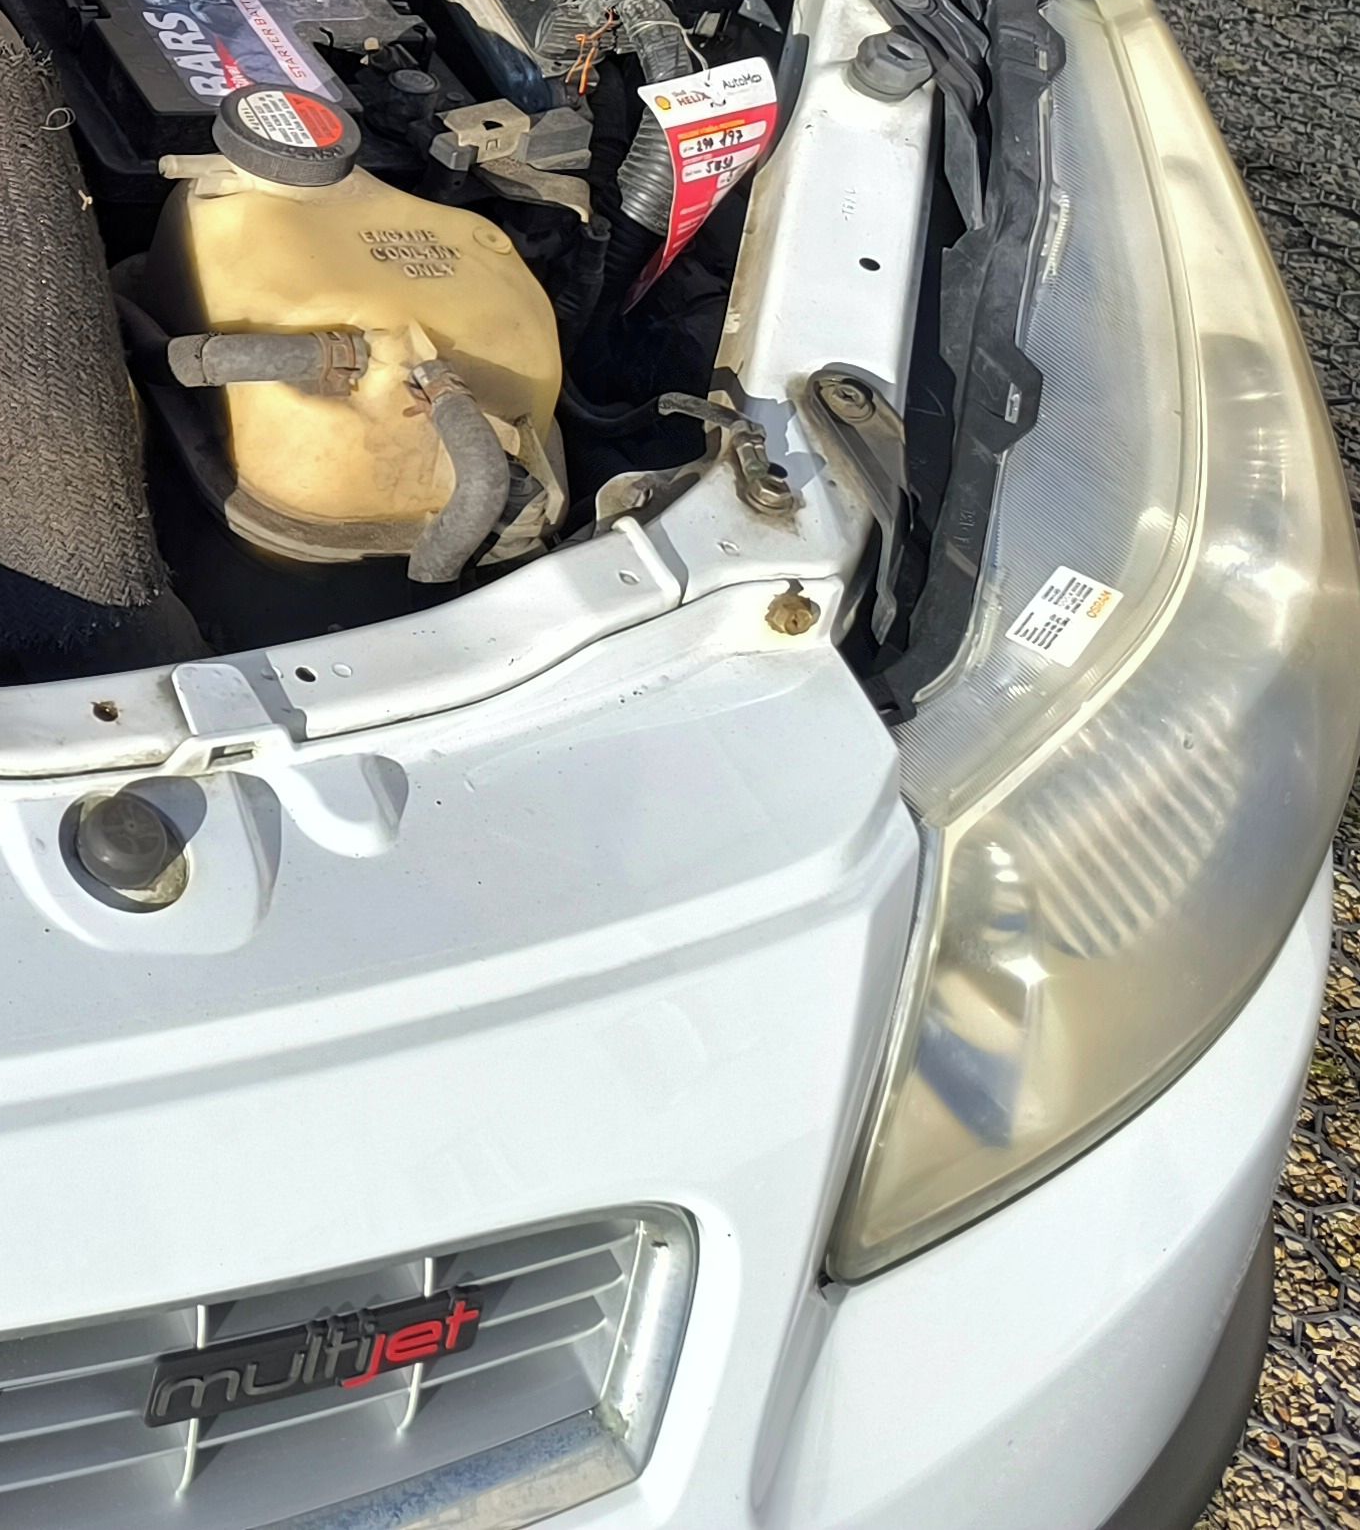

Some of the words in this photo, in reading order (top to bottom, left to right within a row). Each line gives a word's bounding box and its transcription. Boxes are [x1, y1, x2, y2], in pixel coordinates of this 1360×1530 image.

[142, 11, 234, 98] BARS
[261, 25, 307, 79] STARTER
[358, 229, 439, 244] ENGINE
[370, 245, 461, 262] COOLANT
[403, 263, 455, 279] ONLY
[1086, 589, 1113, 619] OSRAM
[153, 1300, 480, 1416] multijet
